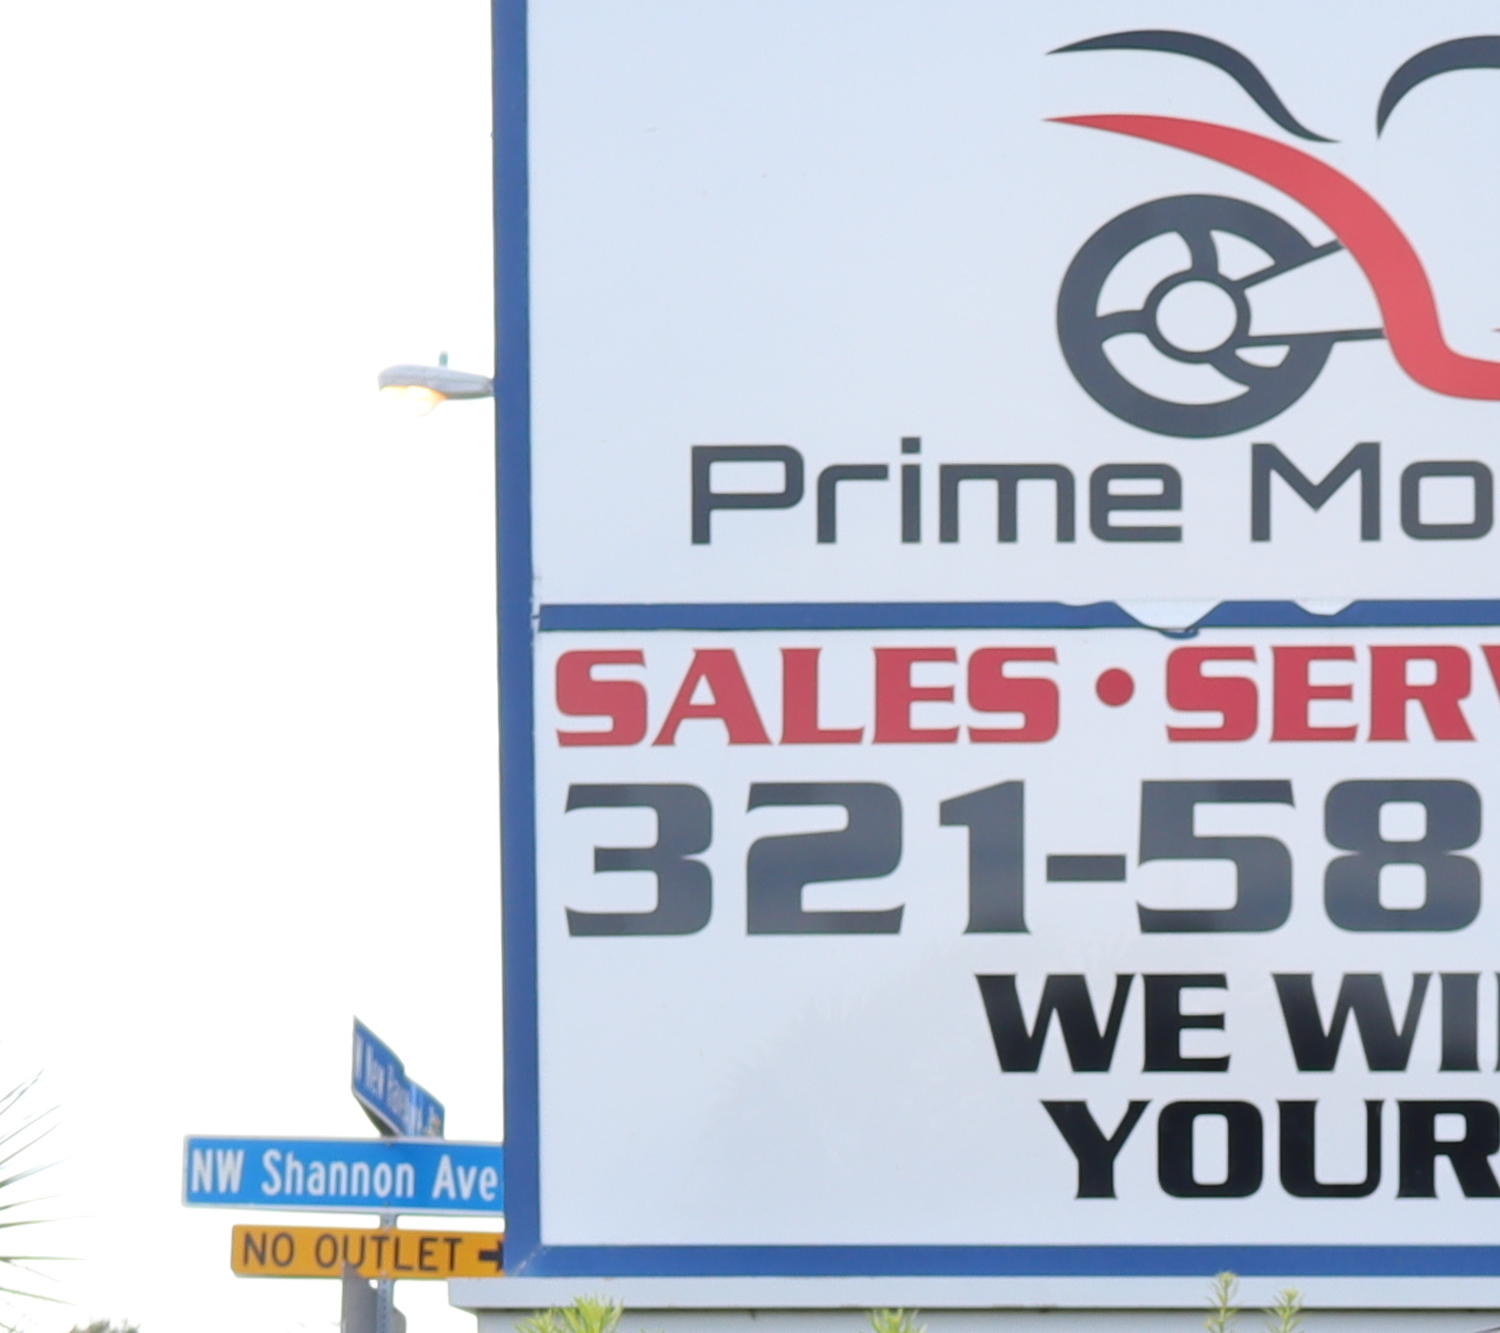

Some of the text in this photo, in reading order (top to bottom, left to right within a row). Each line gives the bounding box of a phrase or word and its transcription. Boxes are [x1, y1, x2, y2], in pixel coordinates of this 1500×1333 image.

[691, 437, 1184, 546] Prime
[555, 647, 1060, 747] SALES
[975, 972, 1232, 1075] WE
[190, 1148, 499, 1202] NW Shannon Ave
[242, 1231, 464, 1273] NO OUTLET
